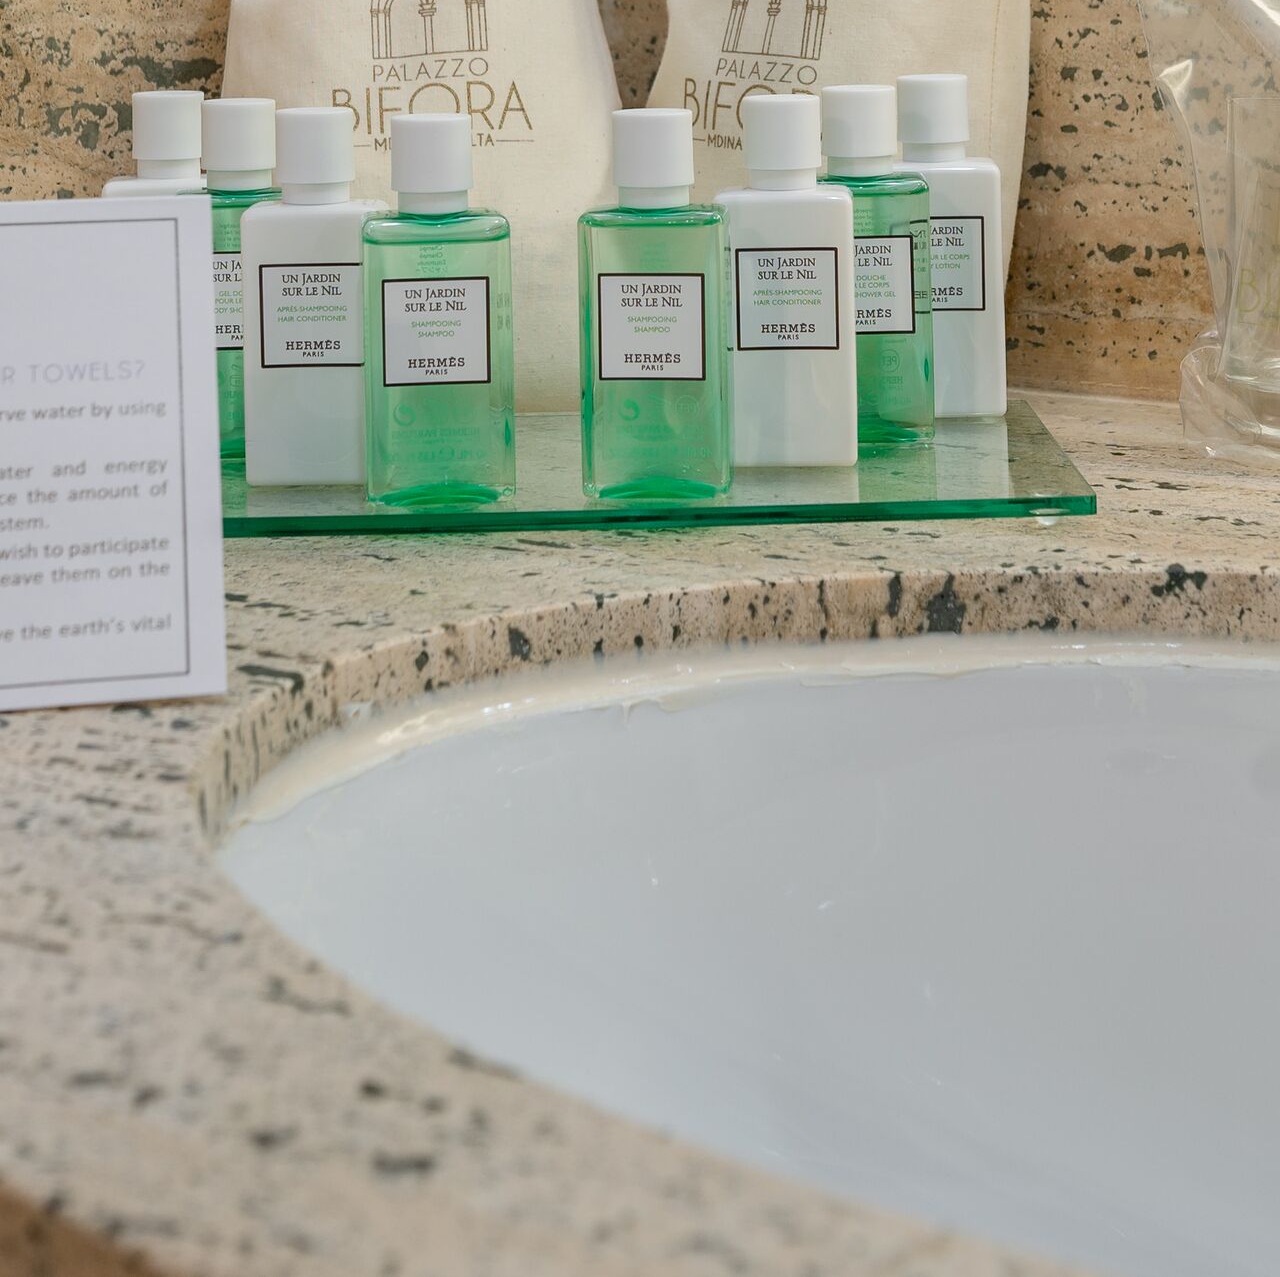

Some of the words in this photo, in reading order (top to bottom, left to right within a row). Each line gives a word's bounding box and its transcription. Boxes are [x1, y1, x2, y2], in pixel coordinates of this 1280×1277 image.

[372, 57, 489, 83] PALAZZO
[716, 58, 817, 85] PALAZZO
[332, 80, 534, 135] BIFORA
[707, 134, 743, 151] MDINA
[931, 226, 964, 235] ARDIN
[931, 238, 943, 247] LE
[945, 236, 965, 247] NIL
[855, 245, 892, 256] JARDIN
[212, 261, 228, 270] UN
[757, 258, 775, 268] UN
[777, 257, 816, 270] JARDIN
[858, 257, 870, 267] LE
[872, 256, 893, 267] NIL
[213, 274, 232, 282] SUR
[282, 274, 298, 284] UN
[302, 273, 341, 286] JARDIN
[757, 271, 779, 280] SUR
[781, 271, 793, 280] LE
[796, 269, 817, 280] NIL
[282, 287, 302, 296] SUR
[305, 287, 318, 296] LE
[321, 285, 342, 296] NIL
[405, 289, 422, 299] UN
[426, 288, 466, 301] JARDIN
[621, 284, 638, 294] UN
[642, 283, 682, 297] JARDIN
[405, 303, 426, 313] SUR
[429, 302, 442, 312] LE
[445, 300, 467, 312] NIL
[621, 298, 642, 307] SUR
[645, 297, 658, 307] LE
[662, 296, 683, 307] NIL
[278, 315, 294, 323] HAIR
[411, 320, 462, 328] SHAMPOOING
[418, 330, 455, 338] SHAMPOO
[761, 322, 816, 334] HERMÈS
[286, 339, 341, 351] HERMÈS
[408, 356, 465, 369] HERMÈS
[624, 352, 681, 364] HERMÈS
[29, 360, 147, 384] TOWELS?
[32, 405, 84, 420] water
[90, 402, 113, 420] by
[118, 401, 166, 418] using
[51, 461, 87, 478] and
[104, 458, 168, 476] energy
[27, 489, 58, 504] the
[67, 484, 140, 502] amount
[149, 480, 168, 497] of
[44, 543, 64, 559] to
[69, 536, 170, 558] participate
[51, 567, 100, 583] them
[108, 566, 132, 580] on
[139, 560, 170, 577] the
[21, 624, 52, 641] the
[130, 614, 171, 632] vital
